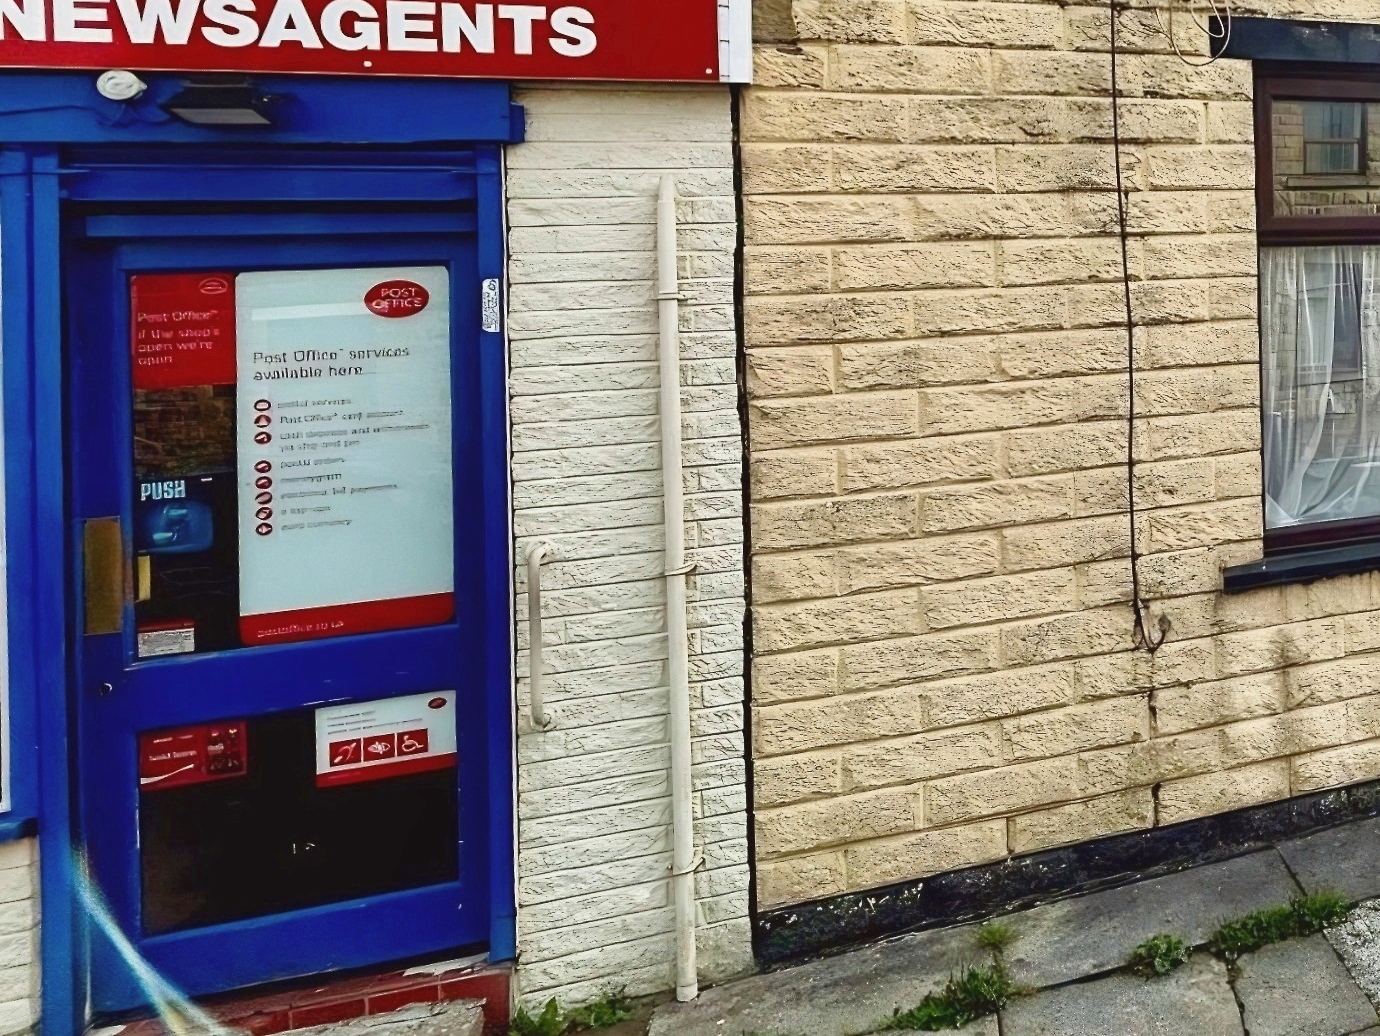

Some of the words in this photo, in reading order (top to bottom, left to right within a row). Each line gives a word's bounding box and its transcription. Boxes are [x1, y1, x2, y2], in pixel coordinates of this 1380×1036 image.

[381, 287, 417, 298] POST
[372, 297, 423, 309] OFFICE
[253, 351, 287, 365] Post
[349, 346, 410, 360] services
[253, 365, 322, 381] available
[140, 480, 186, 501] PUSH
